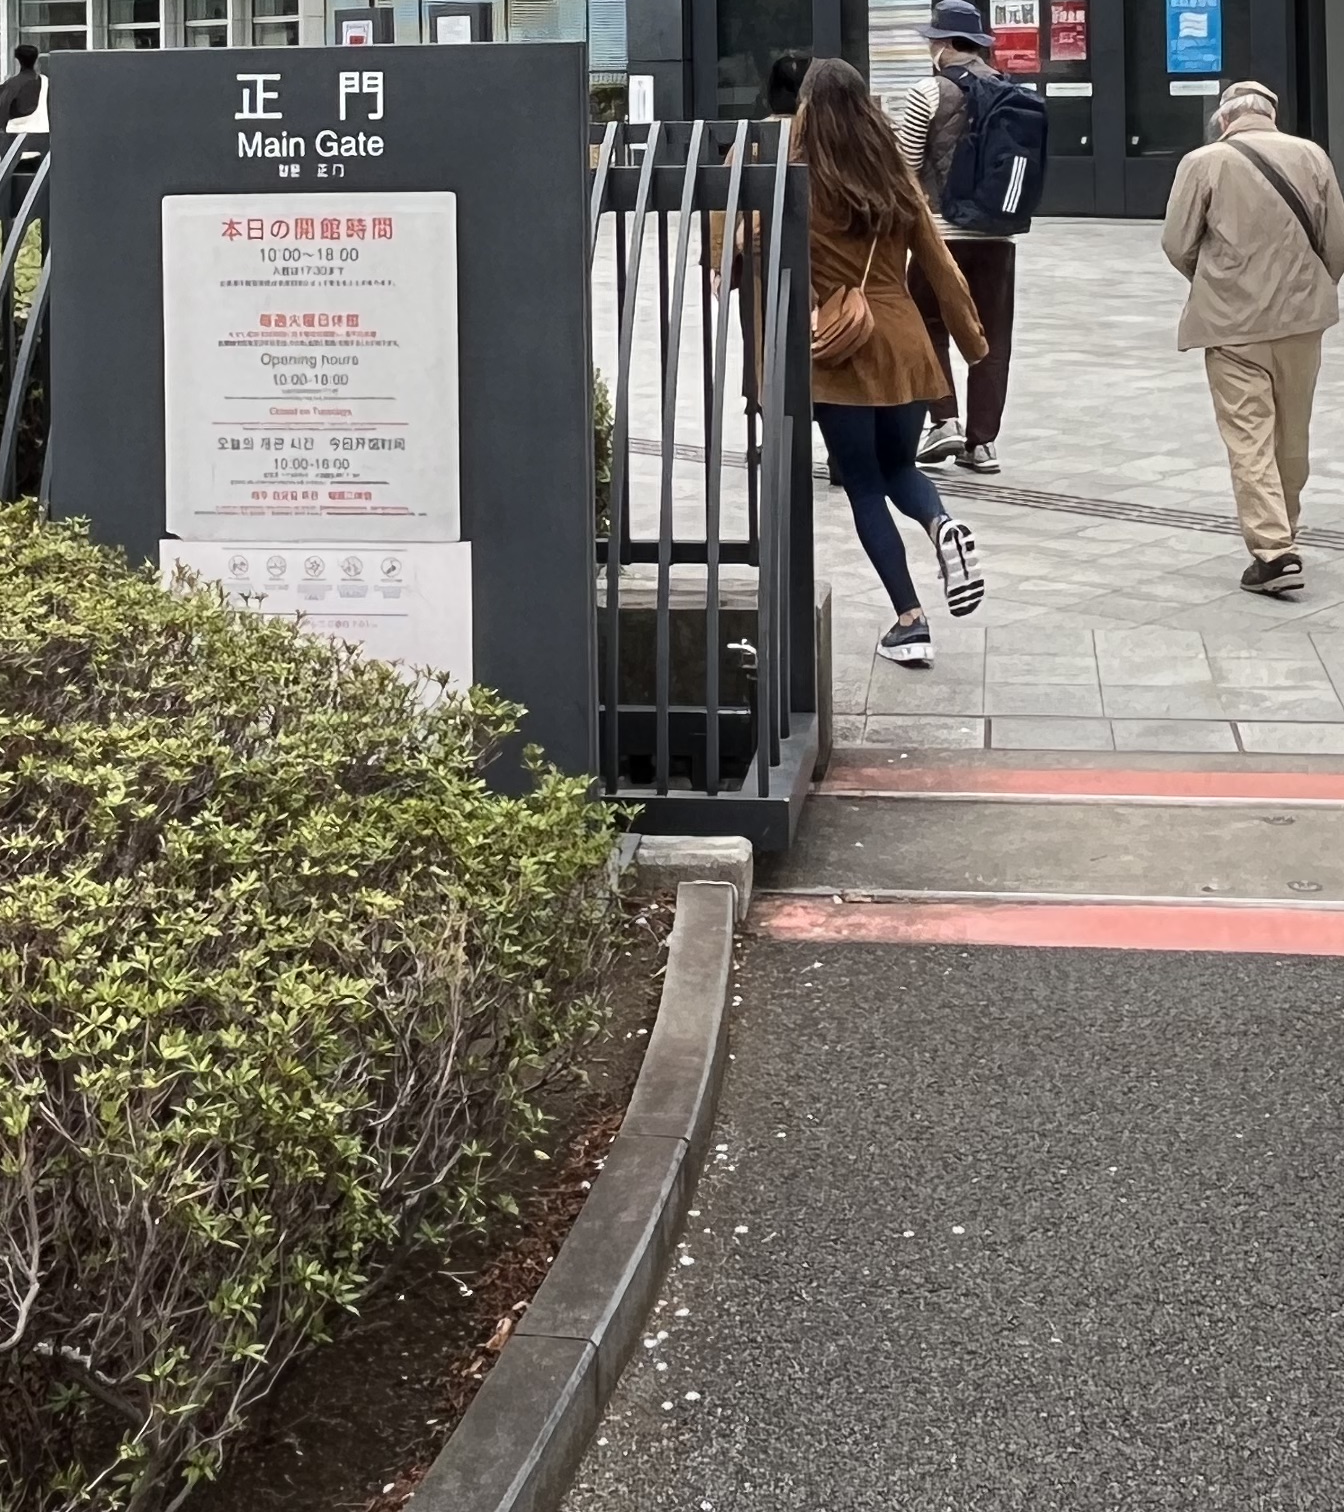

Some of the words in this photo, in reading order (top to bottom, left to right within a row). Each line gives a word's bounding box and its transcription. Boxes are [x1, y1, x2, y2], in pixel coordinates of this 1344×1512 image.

[234, 71, 384, 121] 正門
[237, 130, 306, 157] Main
[314, 129, 385, 157] Gate
[221, 217, 393, 241] 本日の開館時間
[260, 352, 317, 369] Opening
